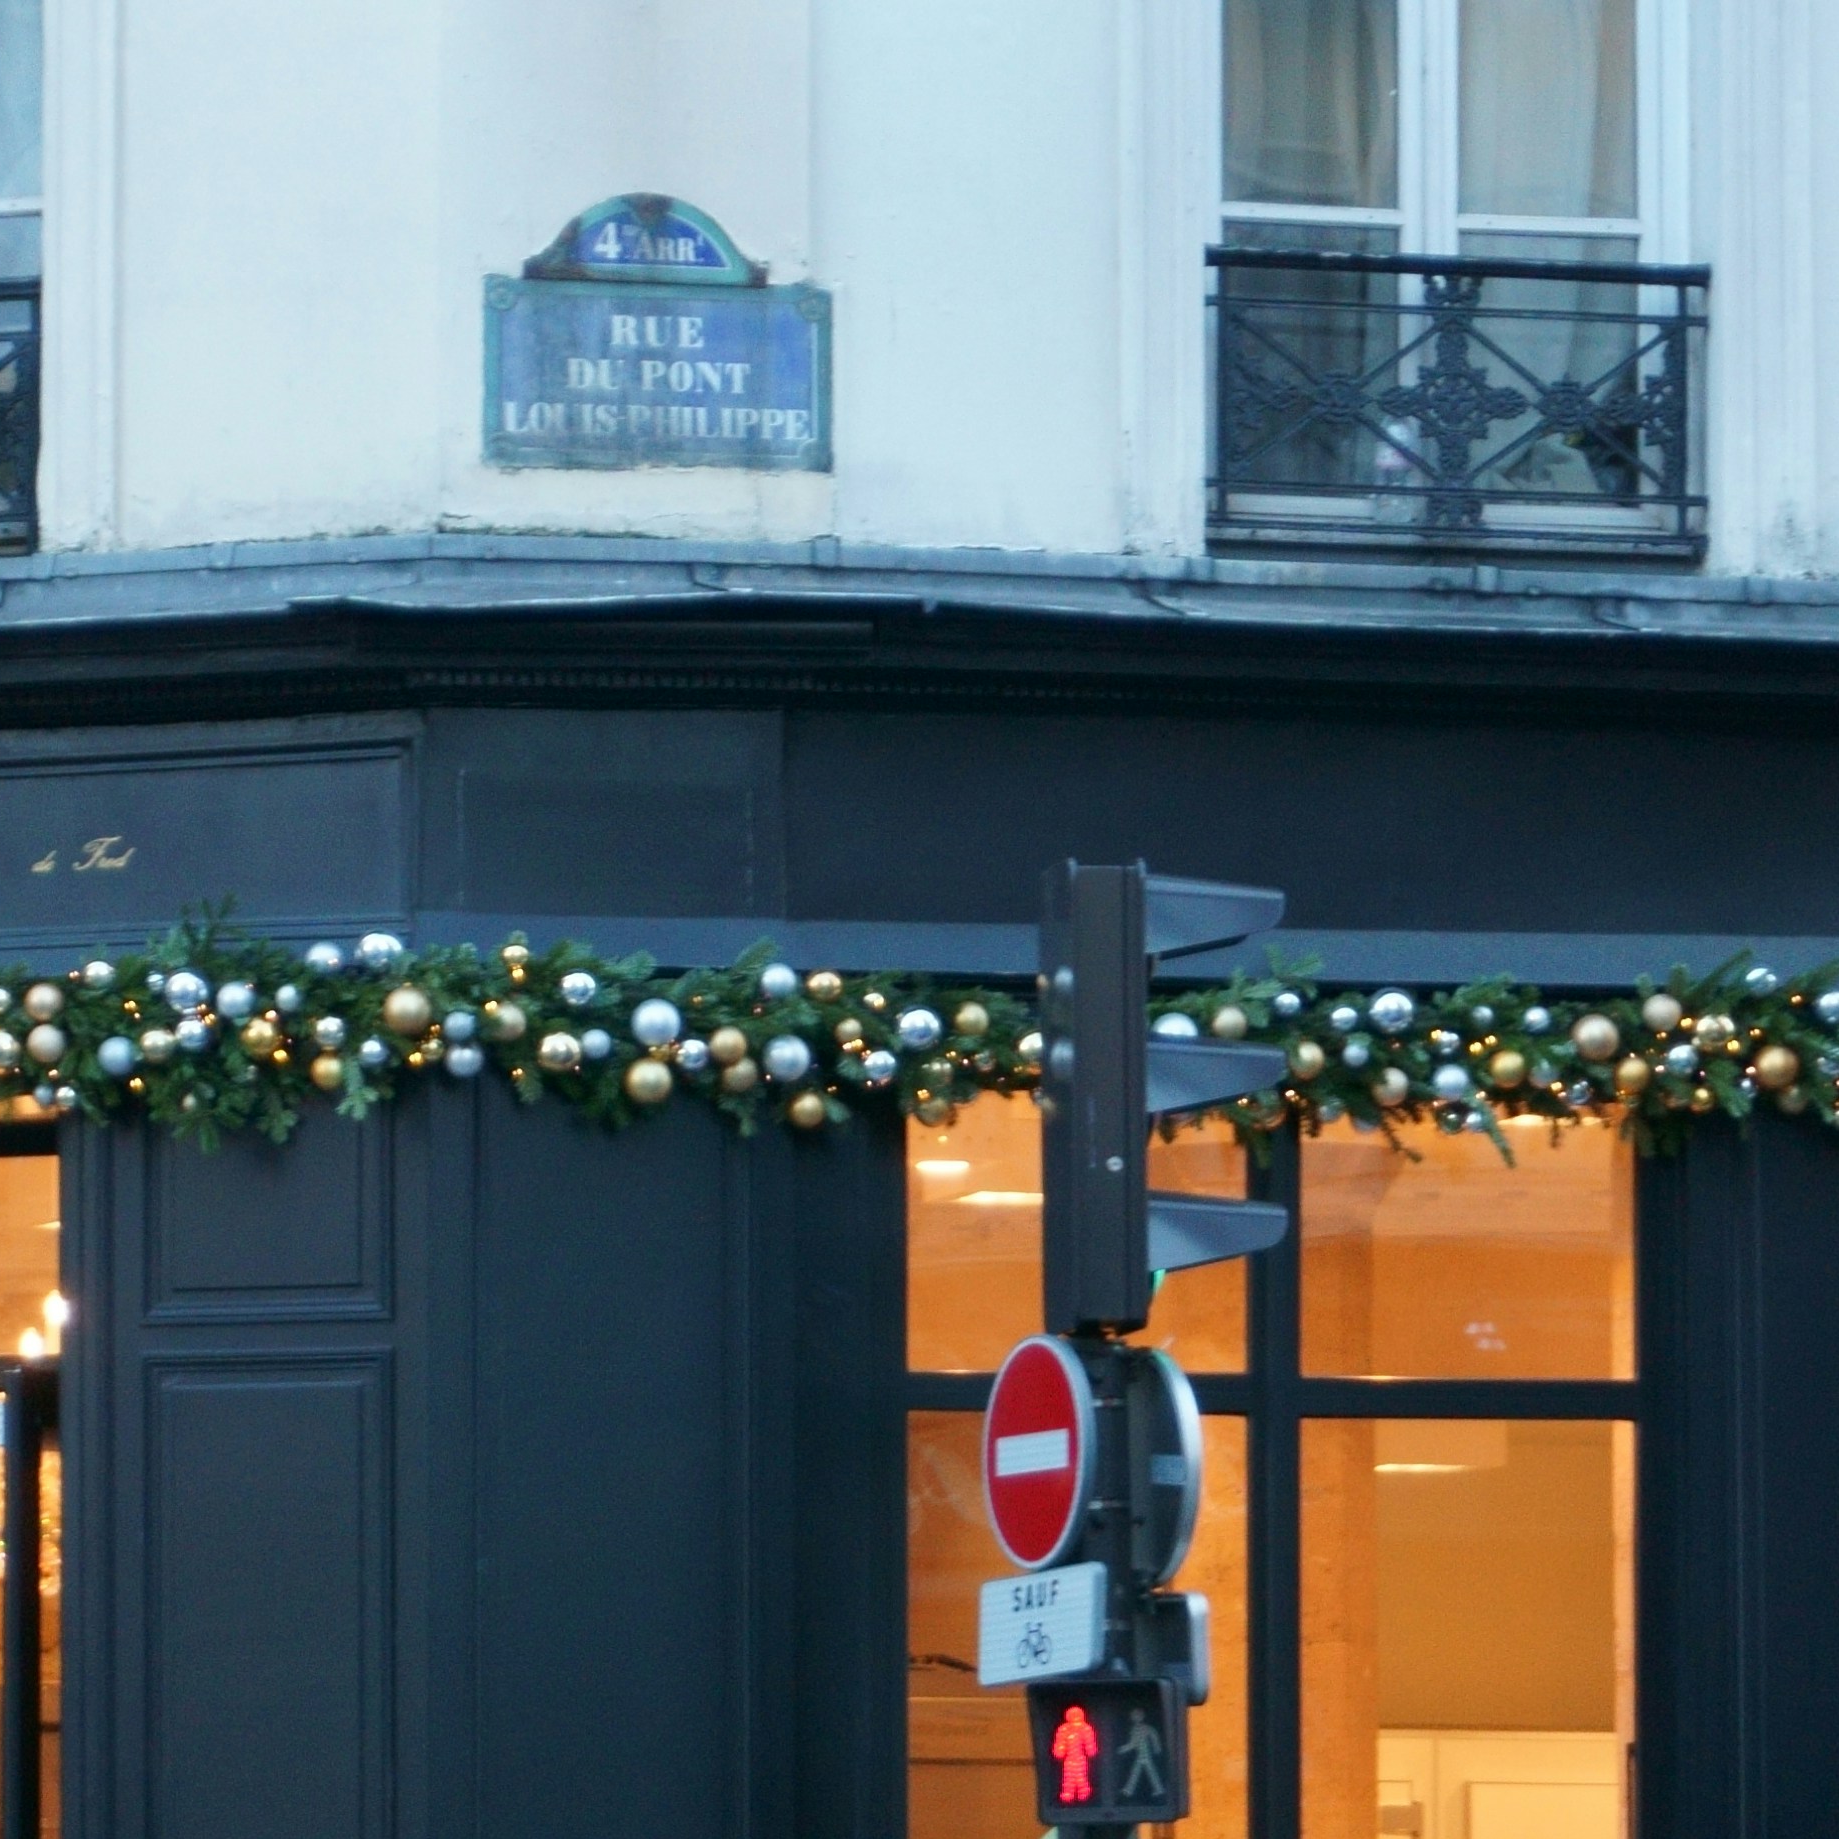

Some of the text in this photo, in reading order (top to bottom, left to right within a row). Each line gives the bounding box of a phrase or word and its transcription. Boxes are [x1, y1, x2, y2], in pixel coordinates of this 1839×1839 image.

[611, 315, 705, 348] RUE
[567, 358, 751, 394] DU PONT
[502, 401, 811, 440] LOUIS-PHILIPPE
[1012, 1577, 1060, 1613] SAUF
